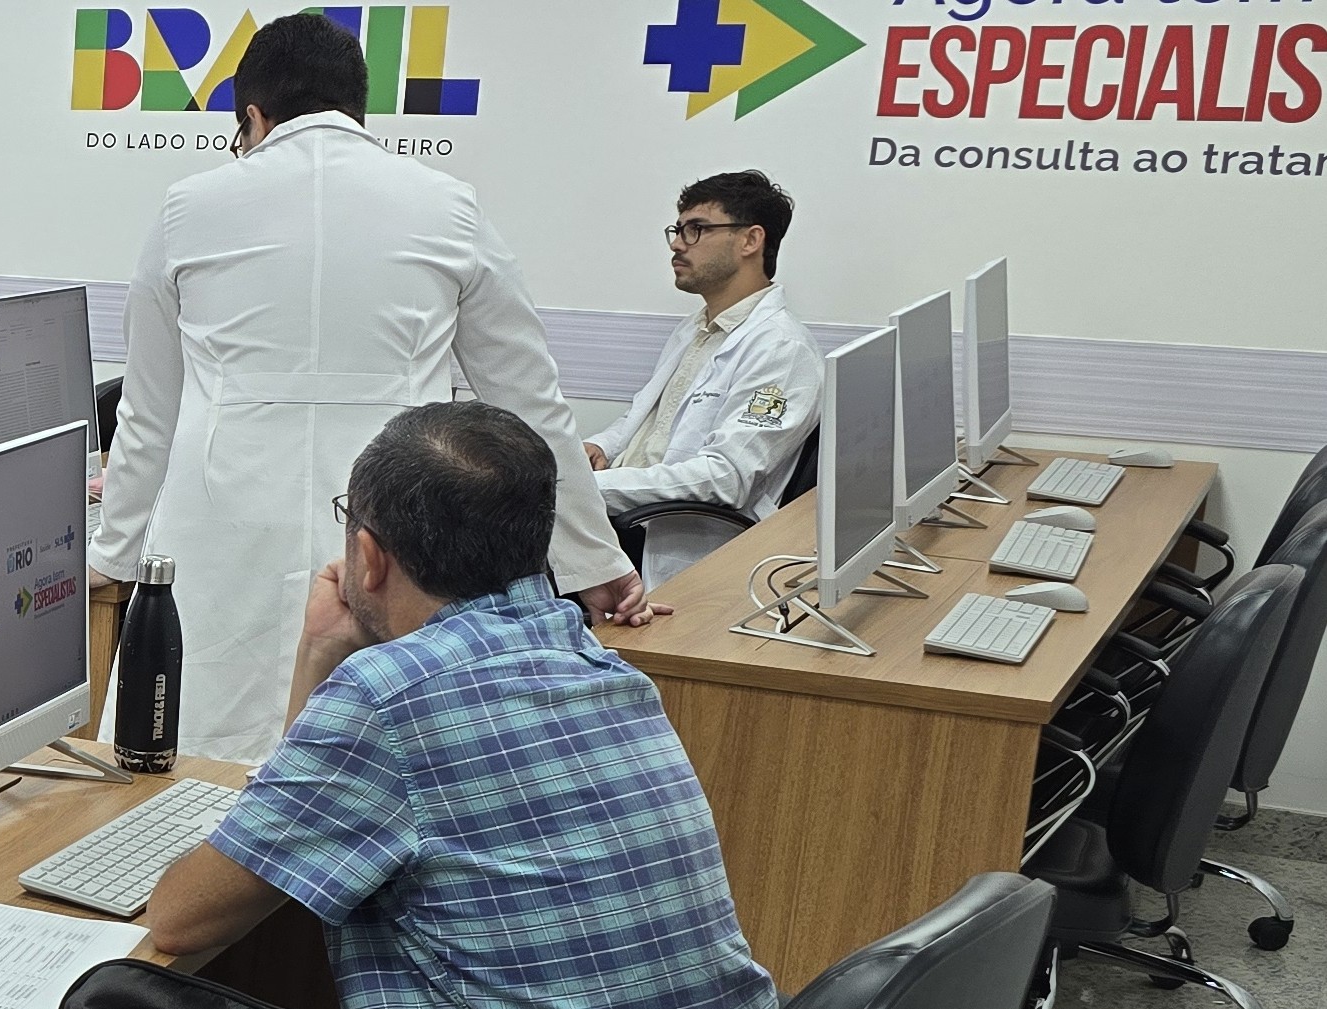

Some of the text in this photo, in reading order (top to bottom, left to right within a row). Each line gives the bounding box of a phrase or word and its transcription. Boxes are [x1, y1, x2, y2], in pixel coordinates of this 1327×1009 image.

[86, 132, 117, 149] DO
[127, 133, 185, 150] LADO
[196, 134, 228, 151] DO
[868, 137, 921, 167] Da
[933, 140, 1120, 172] consulta
[1133, 149, 1188, 174] ao
[15, 546, 33, 571] RIO
[34, 576, 77, 612] ESPECIALISTAS
